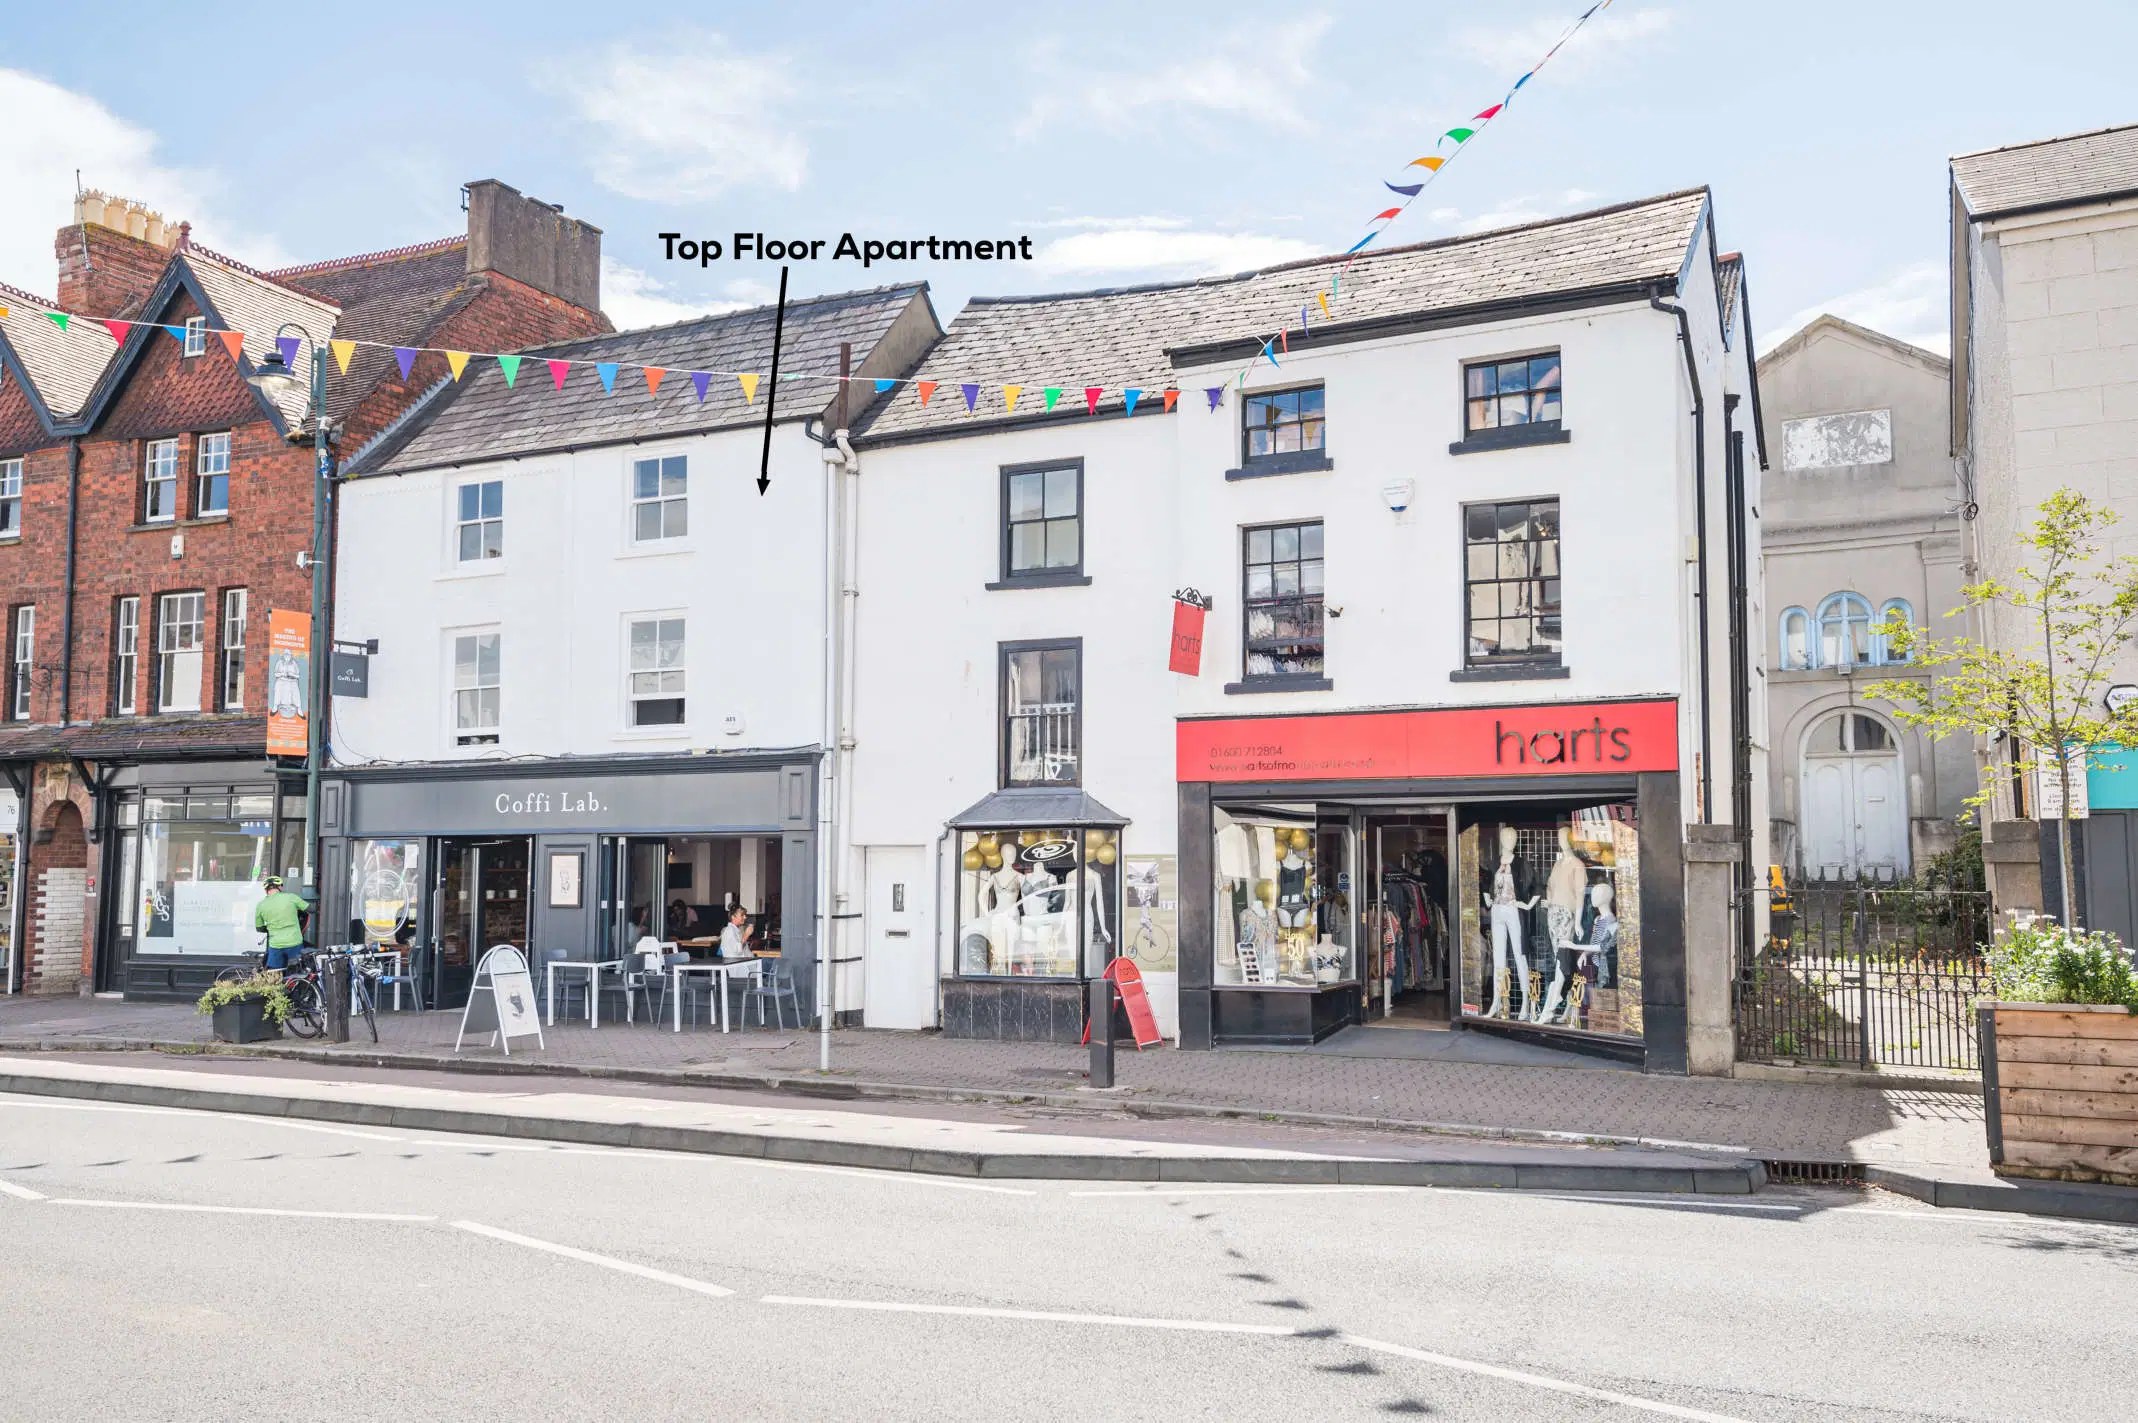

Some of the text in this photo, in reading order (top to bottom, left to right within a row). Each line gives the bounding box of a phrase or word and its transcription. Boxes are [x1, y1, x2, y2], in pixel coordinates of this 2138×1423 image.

[1173, 626, 1201, 655] harts
[1495, 716, 1632, 765] harts
[7, 805, 16, 815] 76
[495, 791, 608, 814] Coffi Lab.
